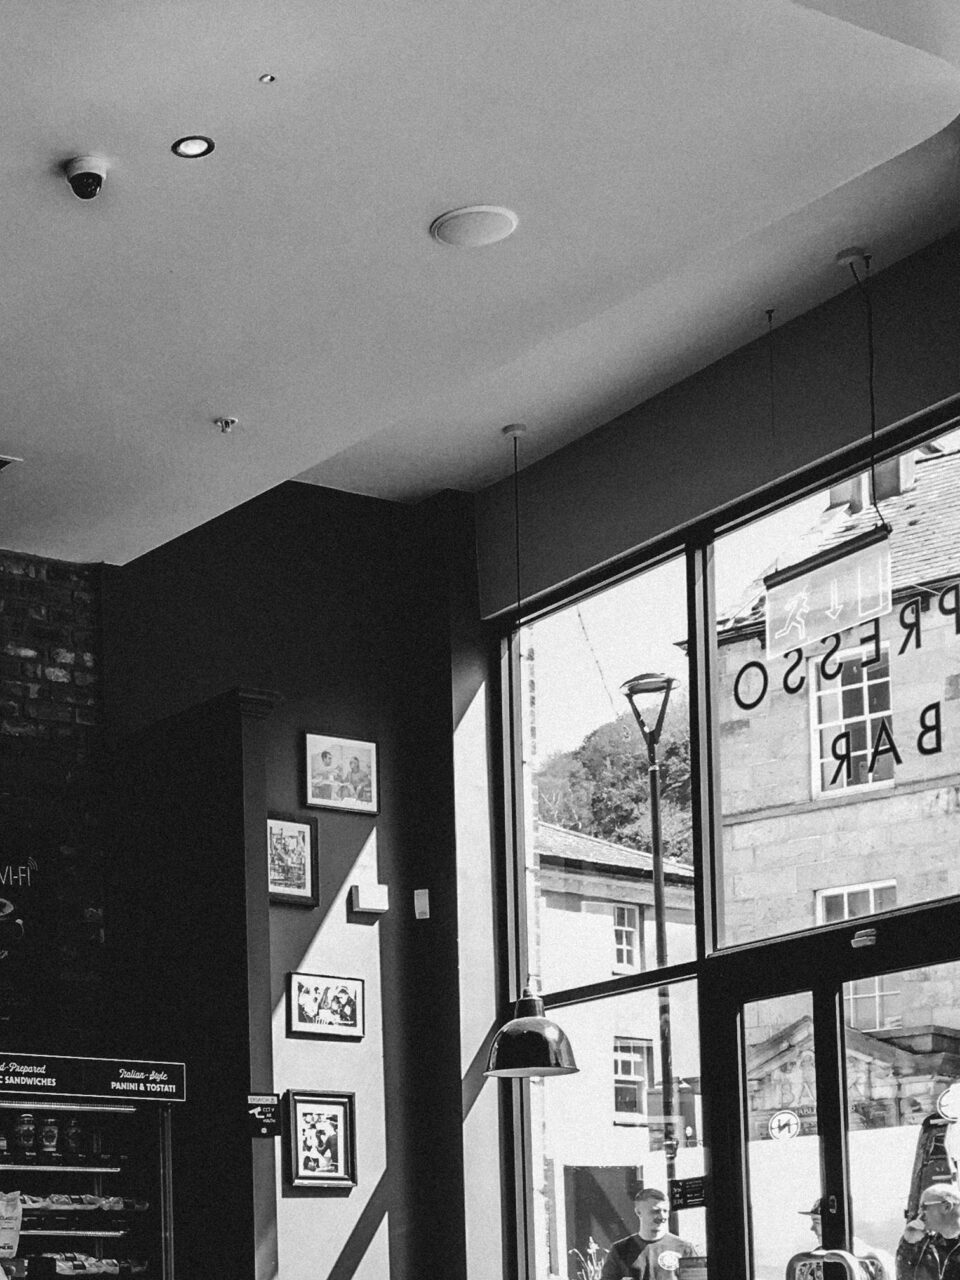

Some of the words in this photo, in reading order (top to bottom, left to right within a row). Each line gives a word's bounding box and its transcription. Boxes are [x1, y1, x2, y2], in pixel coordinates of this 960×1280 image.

[4, 1075, 57, 1086] SANDWICHES
[118, 1068, 168, 1082] Italian-Style
[110, 1081, 138, 1091] PANINI
[138, 1083, 145, 1091] &
[146, 1083, 176, 1093] TOSTATI
